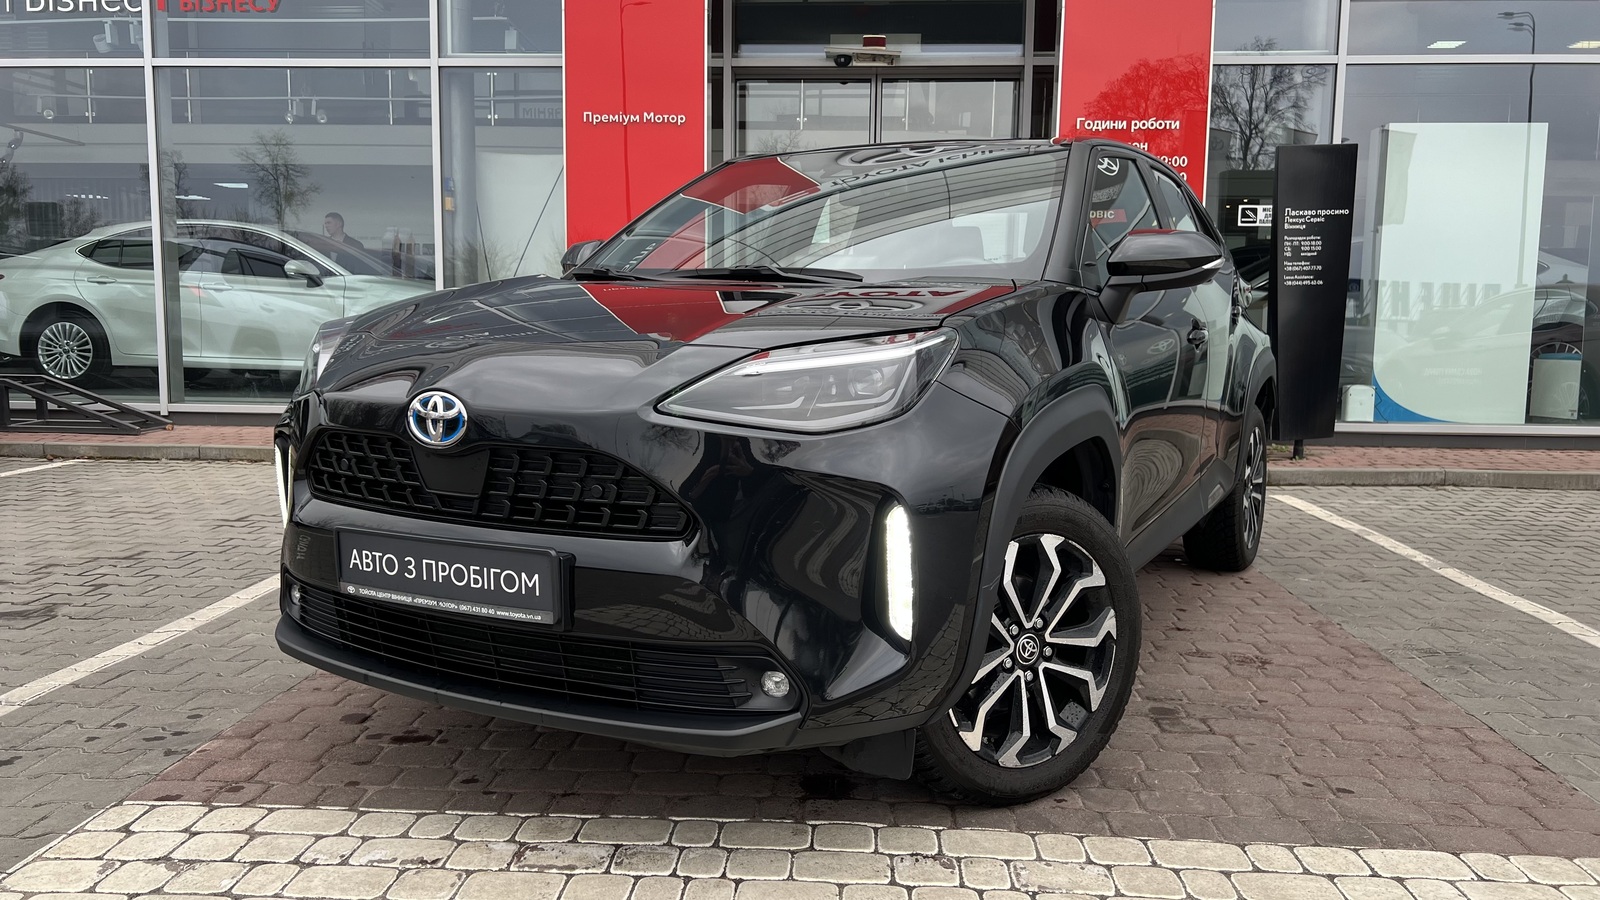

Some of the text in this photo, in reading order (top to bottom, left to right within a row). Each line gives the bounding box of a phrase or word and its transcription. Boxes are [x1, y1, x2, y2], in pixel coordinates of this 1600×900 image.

[583, 111, 686, 125] Преміум Мотор
[1076, 118, 1180, 132] Години роботи
[1285, 208, 1316, 216] Ласкаво
[350, 549, 540, 596] АВТО З ПРОБІГОМ
[359, 588, 376, 597] ТОЙОТА
[459, 604, 472, 612] (067)
[496, 610, 542, 620] www.toyota.vn.ua
